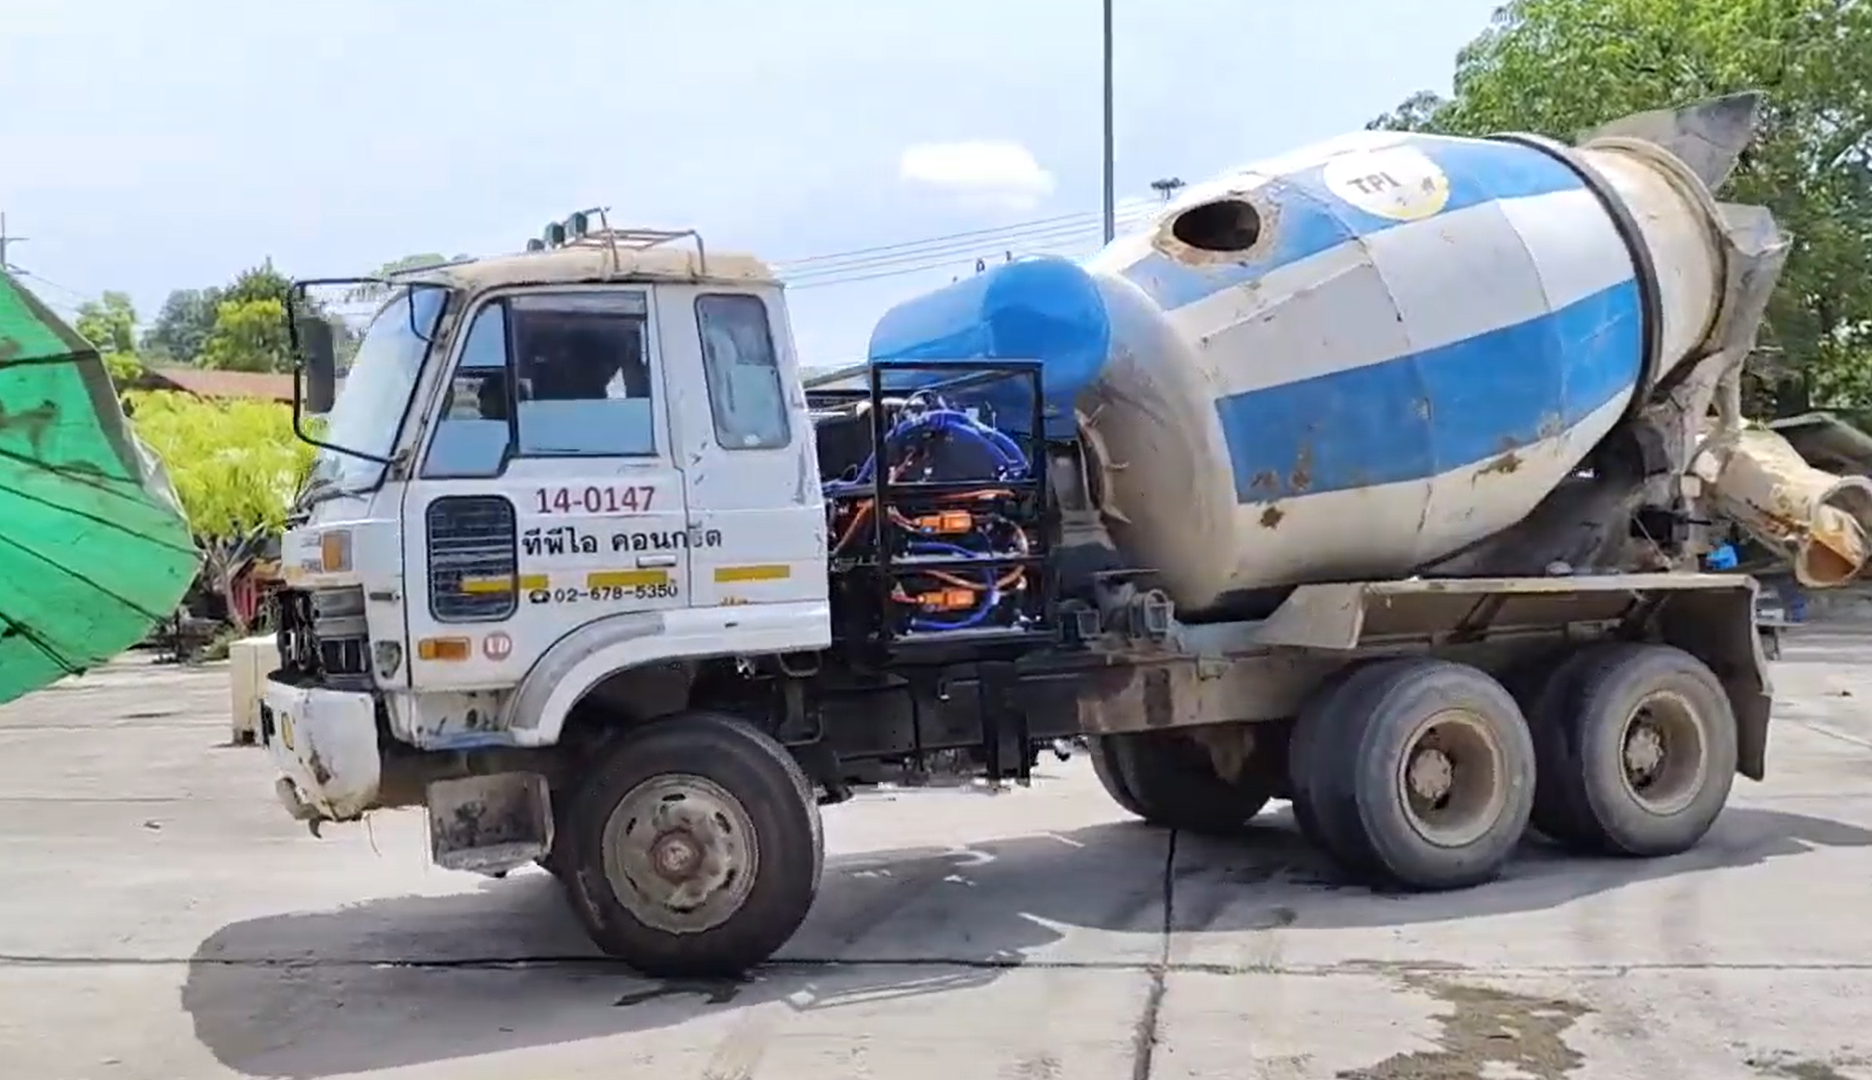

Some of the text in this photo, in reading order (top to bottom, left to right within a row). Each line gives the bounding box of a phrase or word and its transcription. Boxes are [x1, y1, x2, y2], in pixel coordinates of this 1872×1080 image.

[1345, 171, 1401, 194] TPI
[536, 486, 655, 514] 14-0147
[521, 526, 598, 556] ทีพีไอ
[554, 582, 678, 602] 02-678-5350
